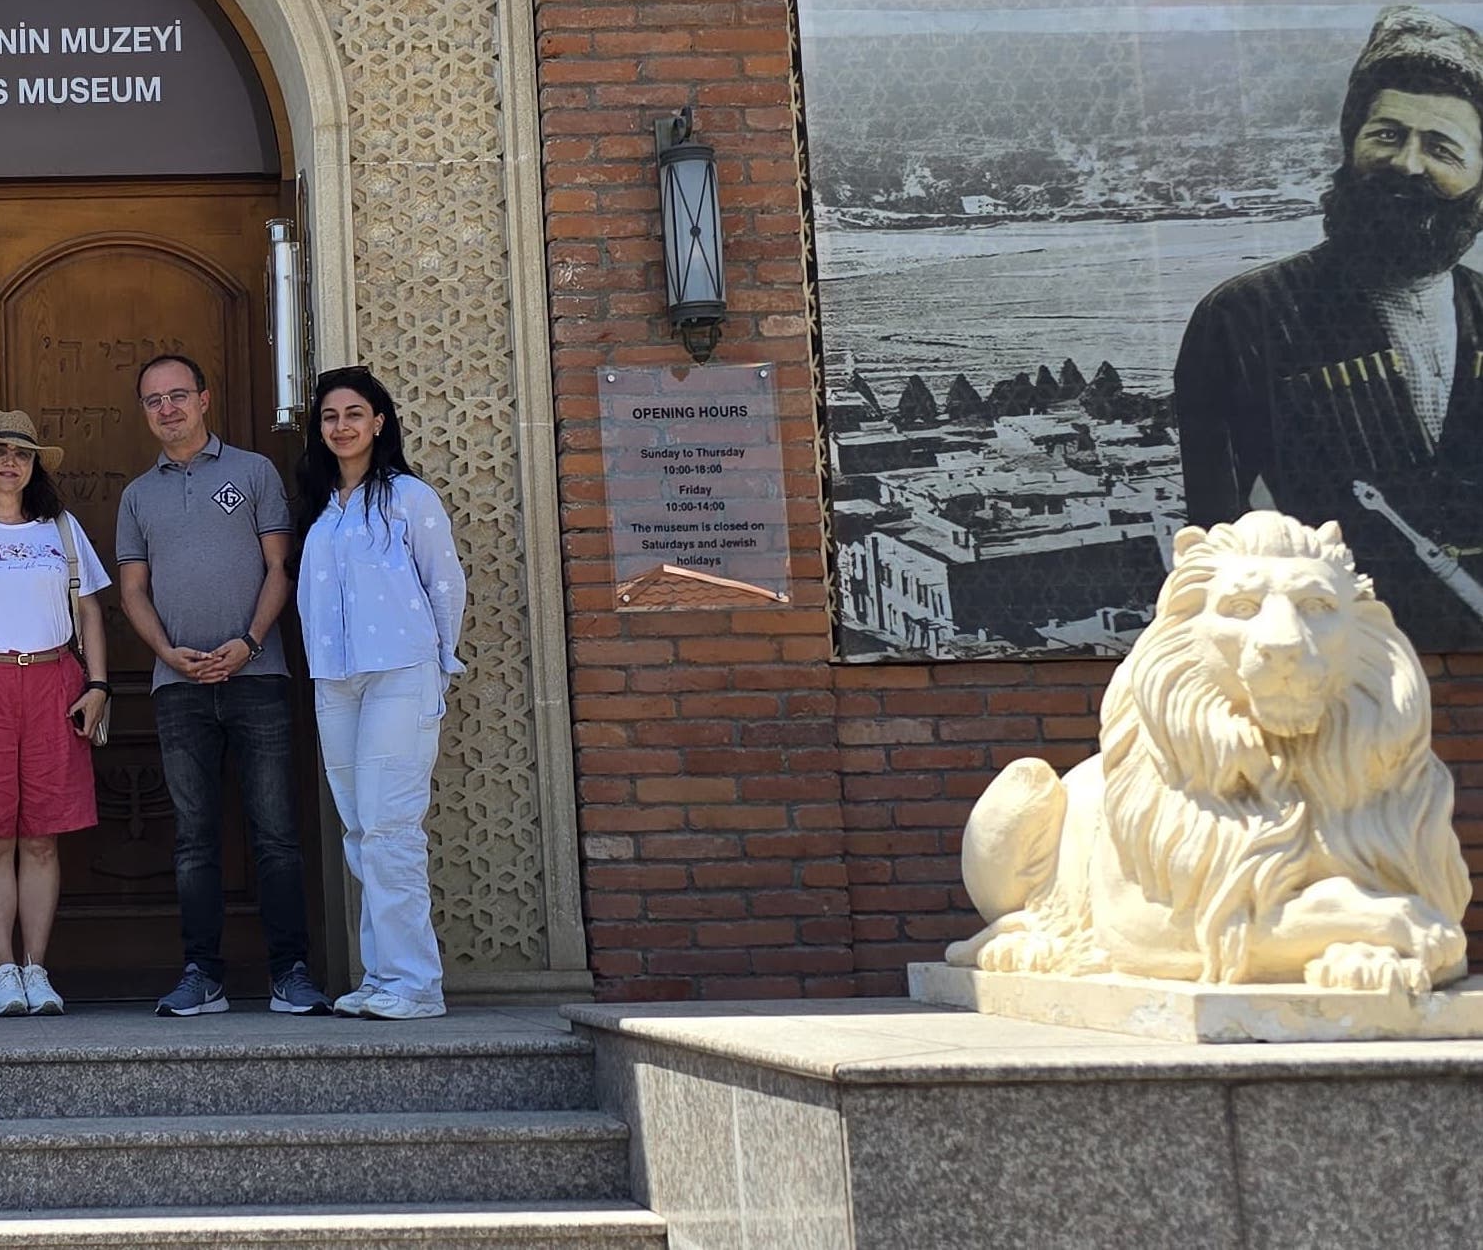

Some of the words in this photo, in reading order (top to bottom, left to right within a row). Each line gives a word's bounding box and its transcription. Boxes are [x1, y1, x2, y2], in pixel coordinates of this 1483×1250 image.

[61, 19, 183, 53] MUZEYİ
[17, 76, 163, 105] MUSEUM
[632, 407, 695, 419] OPENING
[699, 405, 748, 418] HOURS
[640, 448, 680, 460] Sunday
[683, 448, 694, 458] to
[696, 447, 745, 458] Thursday
[679, 485, 712, 495] Friday
[666, 501, 725, 511] 10:00-14:00
[630, 523, 651, 533] The
[654, 523, 698, 532] museum
[702, 521, 711, 531] is
[714, 521, 748, 530] closed
[750, 522, 765, 531] on
[642, 539, 694, 550] Saturdays
[698, 538, 717, 548] and
[720, 537, 757, 548] Jewish
[676, 556, 721, 567] holidays
